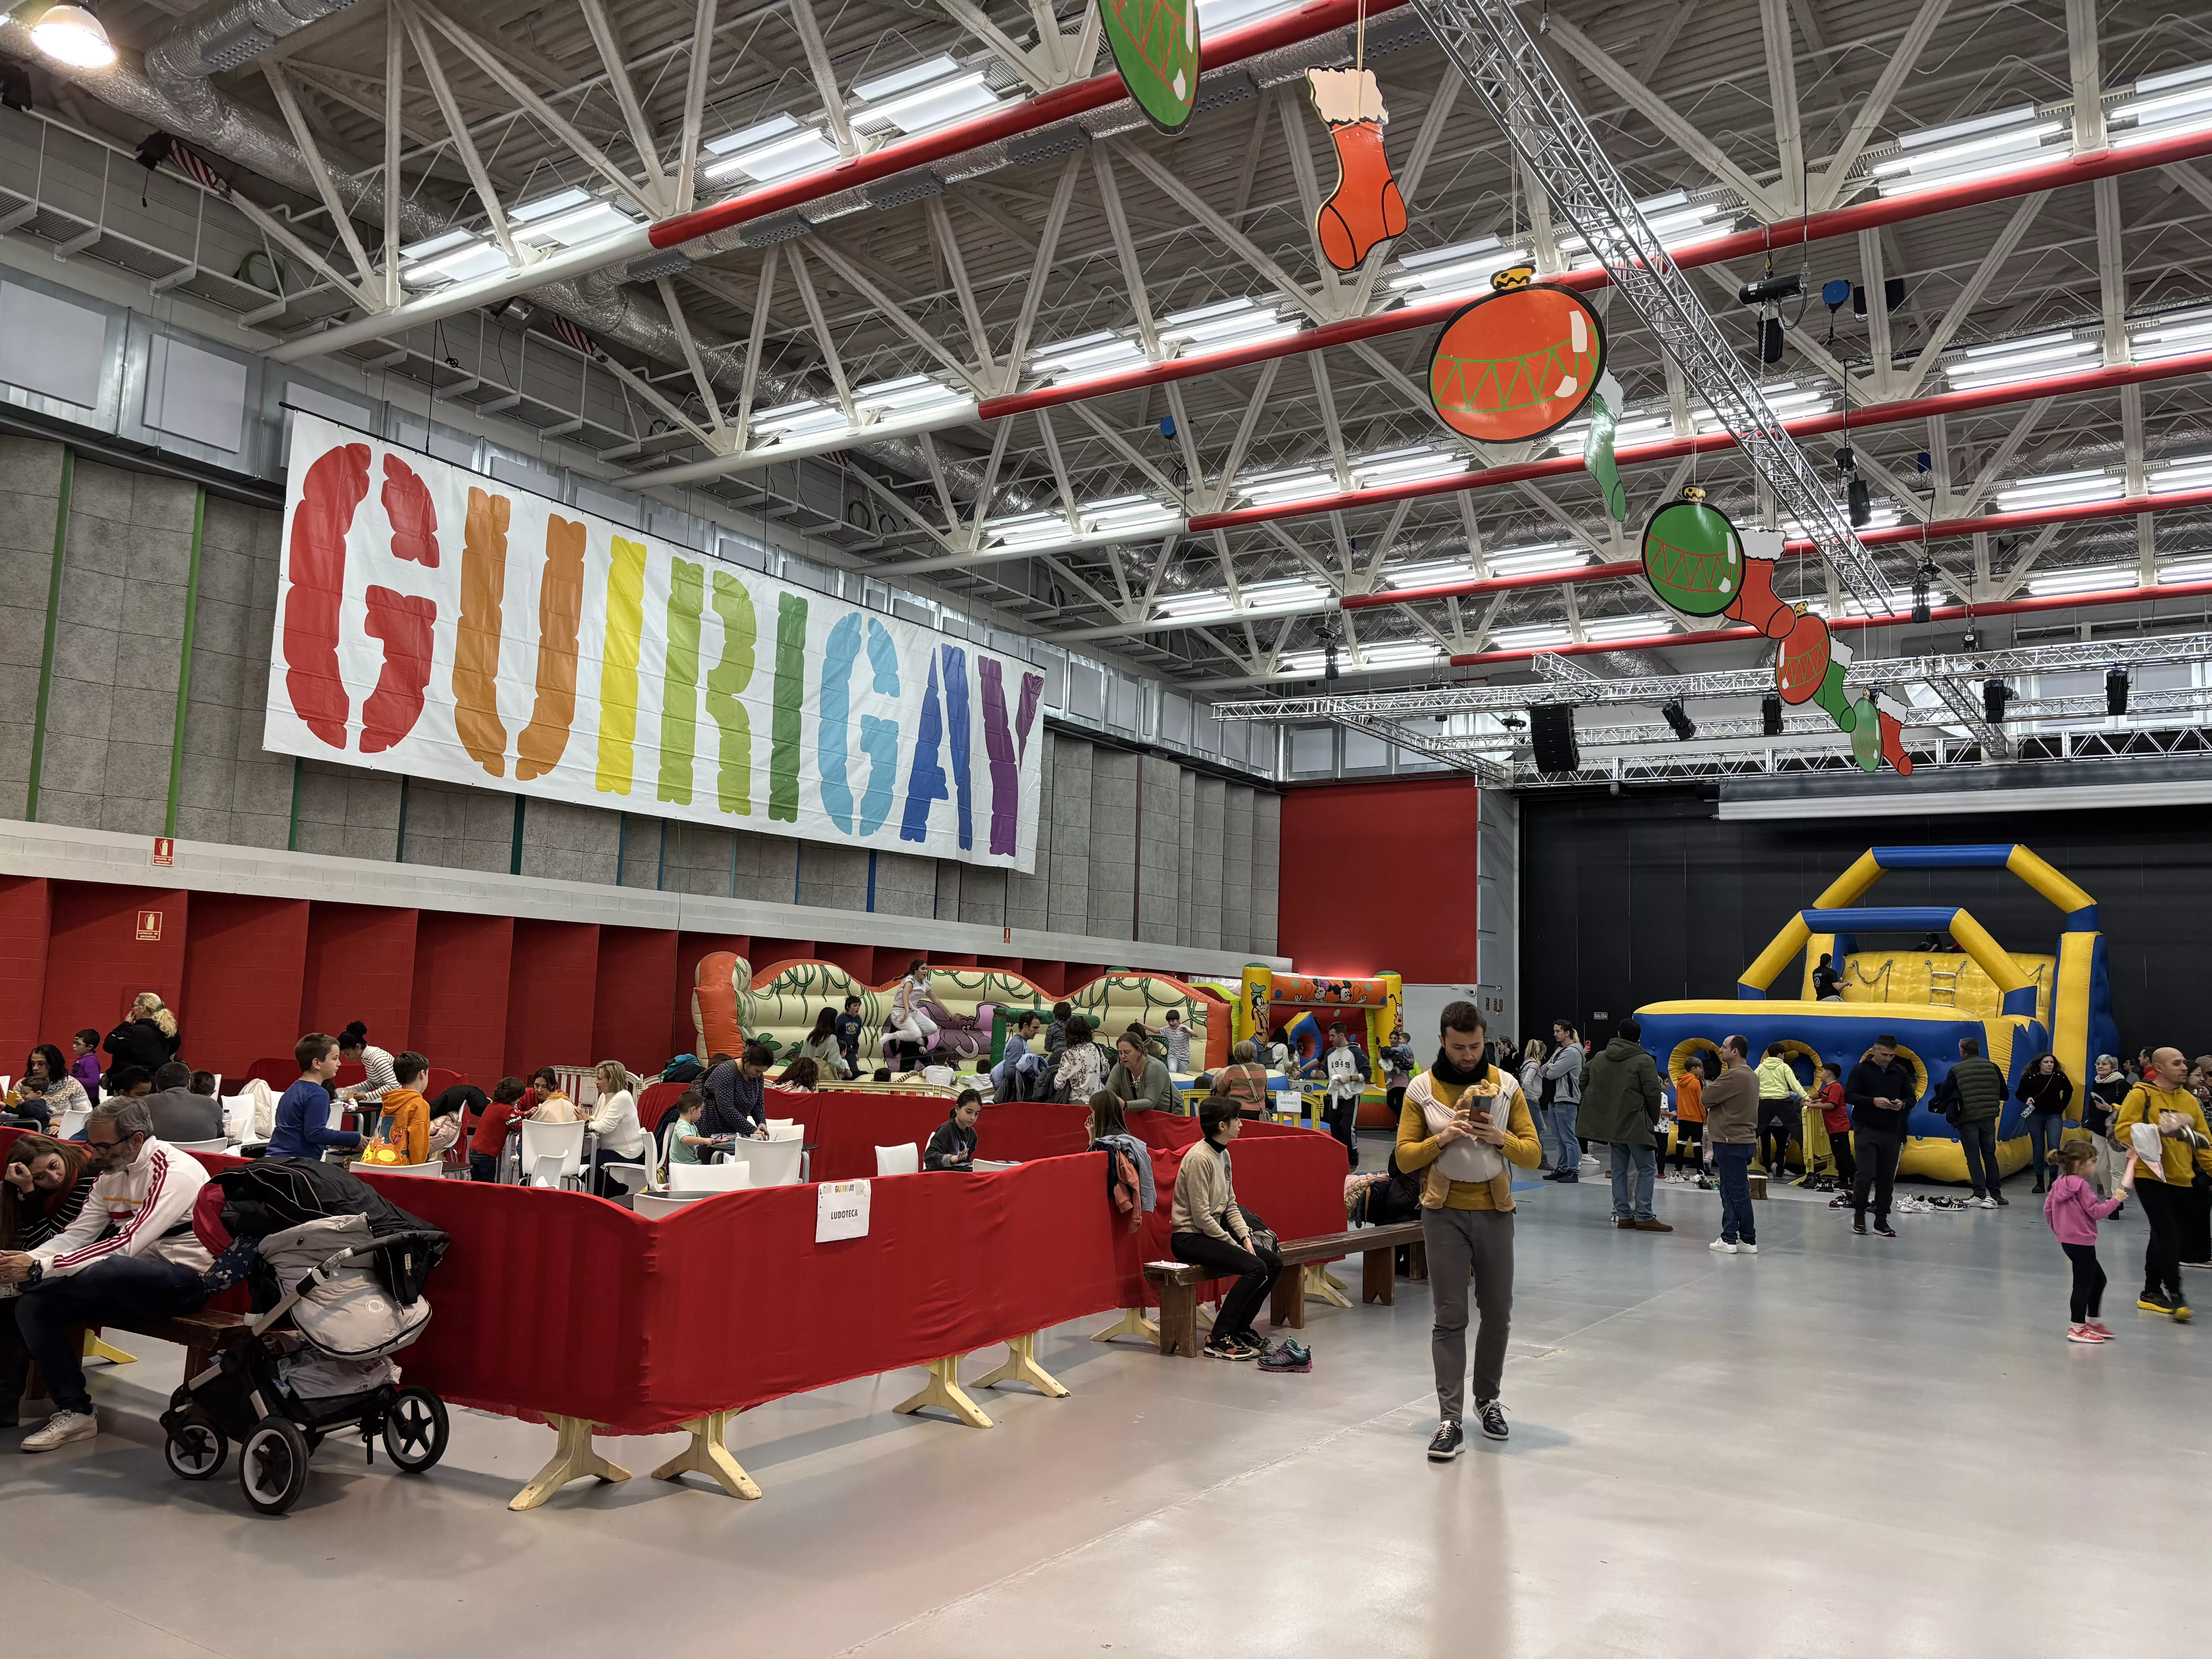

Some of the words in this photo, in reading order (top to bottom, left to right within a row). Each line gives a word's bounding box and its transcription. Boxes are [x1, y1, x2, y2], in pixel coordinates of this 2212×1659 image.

[283, 443, 1044, 857] GUIRIGAY
[835, 1184, 854, 1193] GUIRIGAY
[831, 1209, 858, 1219] LUDOTECA
